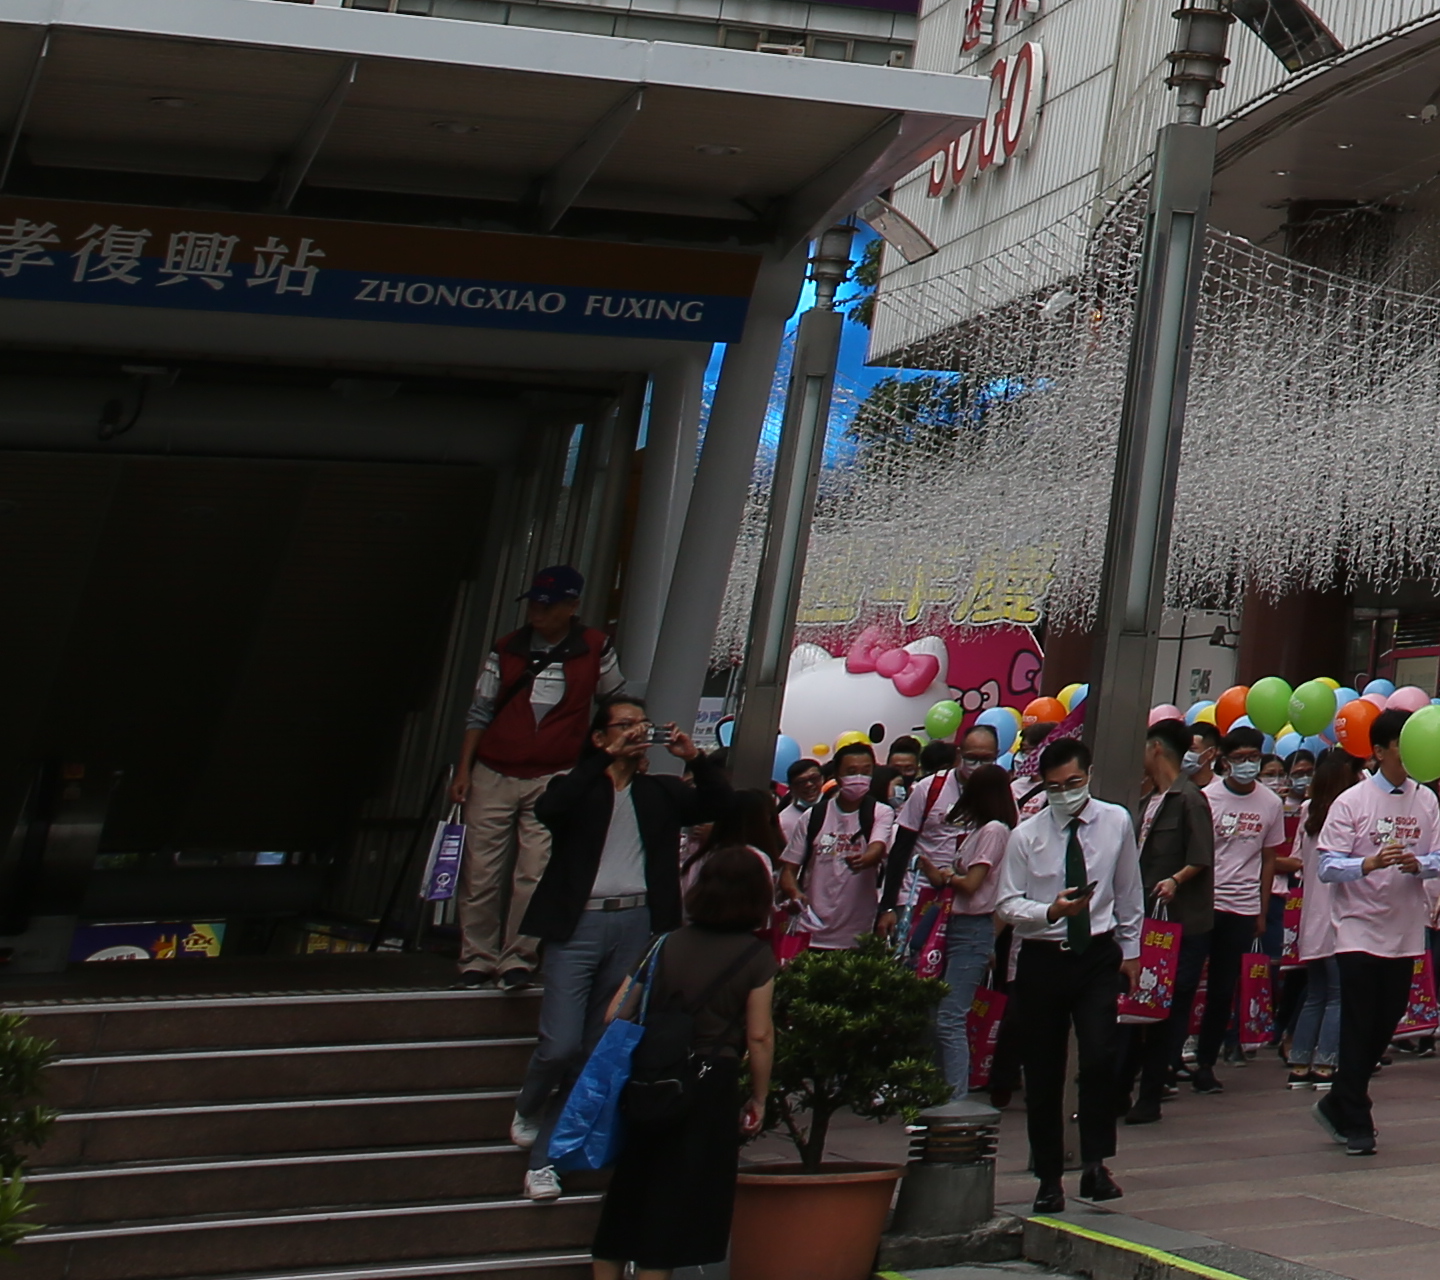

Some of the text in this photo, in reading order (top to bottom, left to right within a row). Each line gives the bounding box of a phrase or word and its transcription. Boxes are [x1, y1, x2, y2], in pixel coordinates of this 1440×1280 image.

[0, 217, 327, 297] 孝復興站
[354, 278, 706, 323] ZHONGXIAO FUXING
[1238, 812, 1261, 822] SOGO
